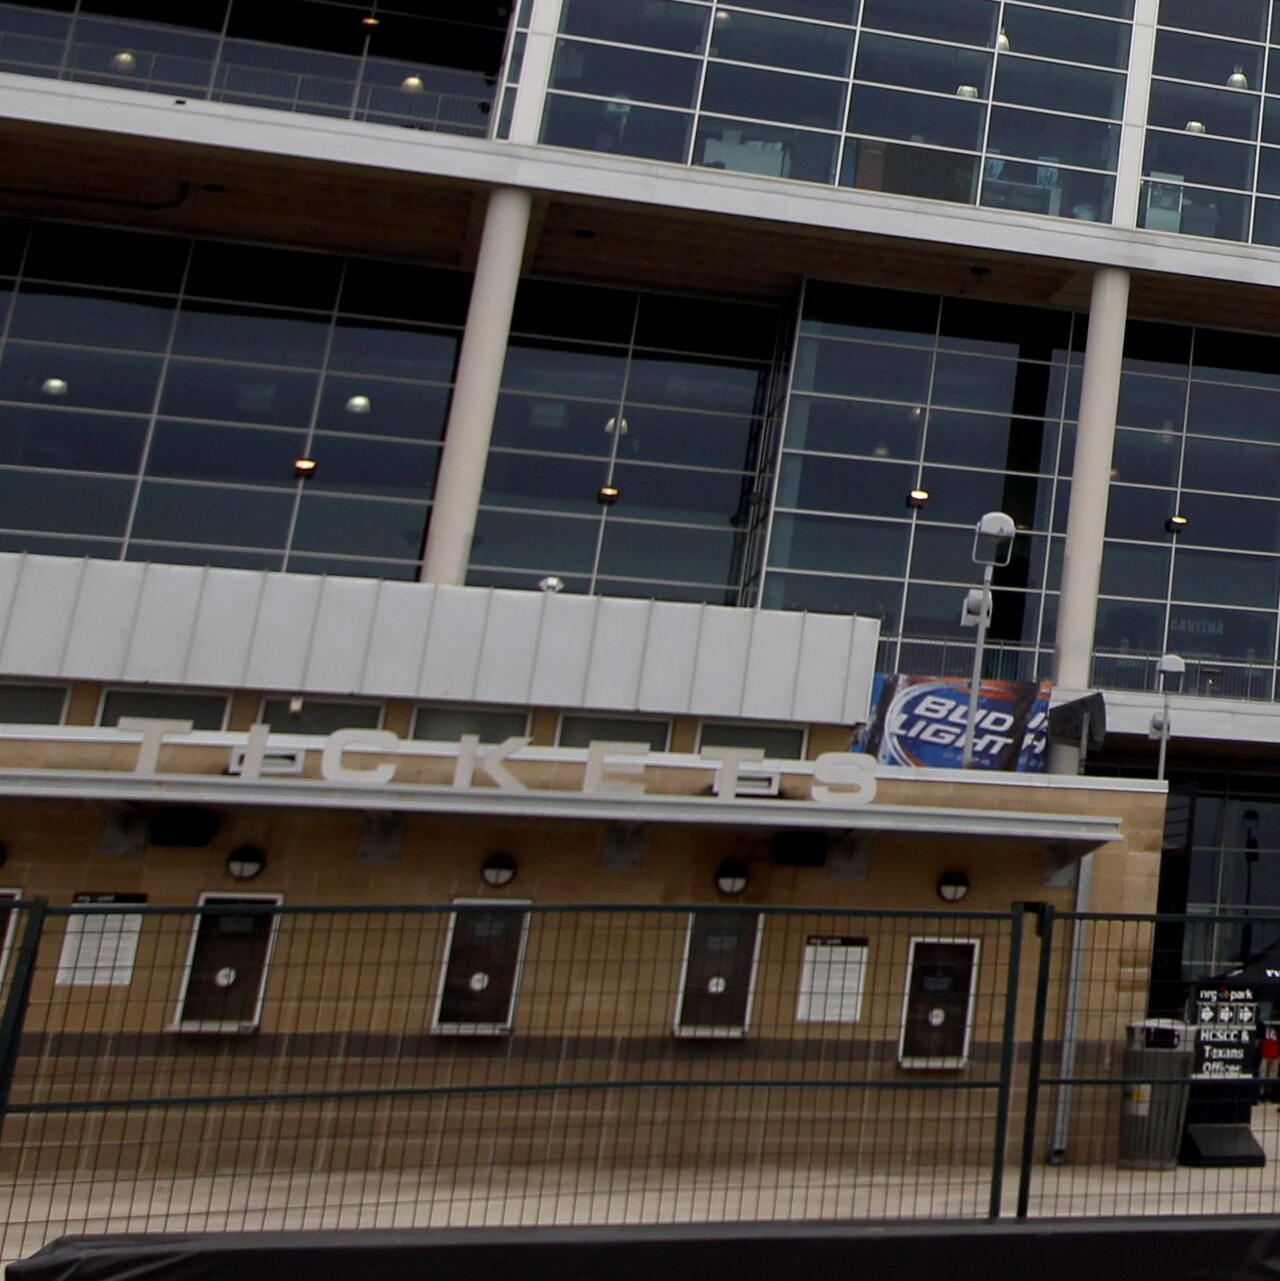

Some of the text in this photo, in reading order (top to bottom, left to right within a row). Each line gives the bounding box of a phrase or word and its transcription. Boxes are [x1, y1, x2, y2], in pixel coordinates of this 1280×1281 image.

[914, 694, 1014, 733] BUD
[889, 713, 1014, 755] LIGHT
[116, 716, 879, 808] TICKETS
[1230, 988, 1253, 1001] park
